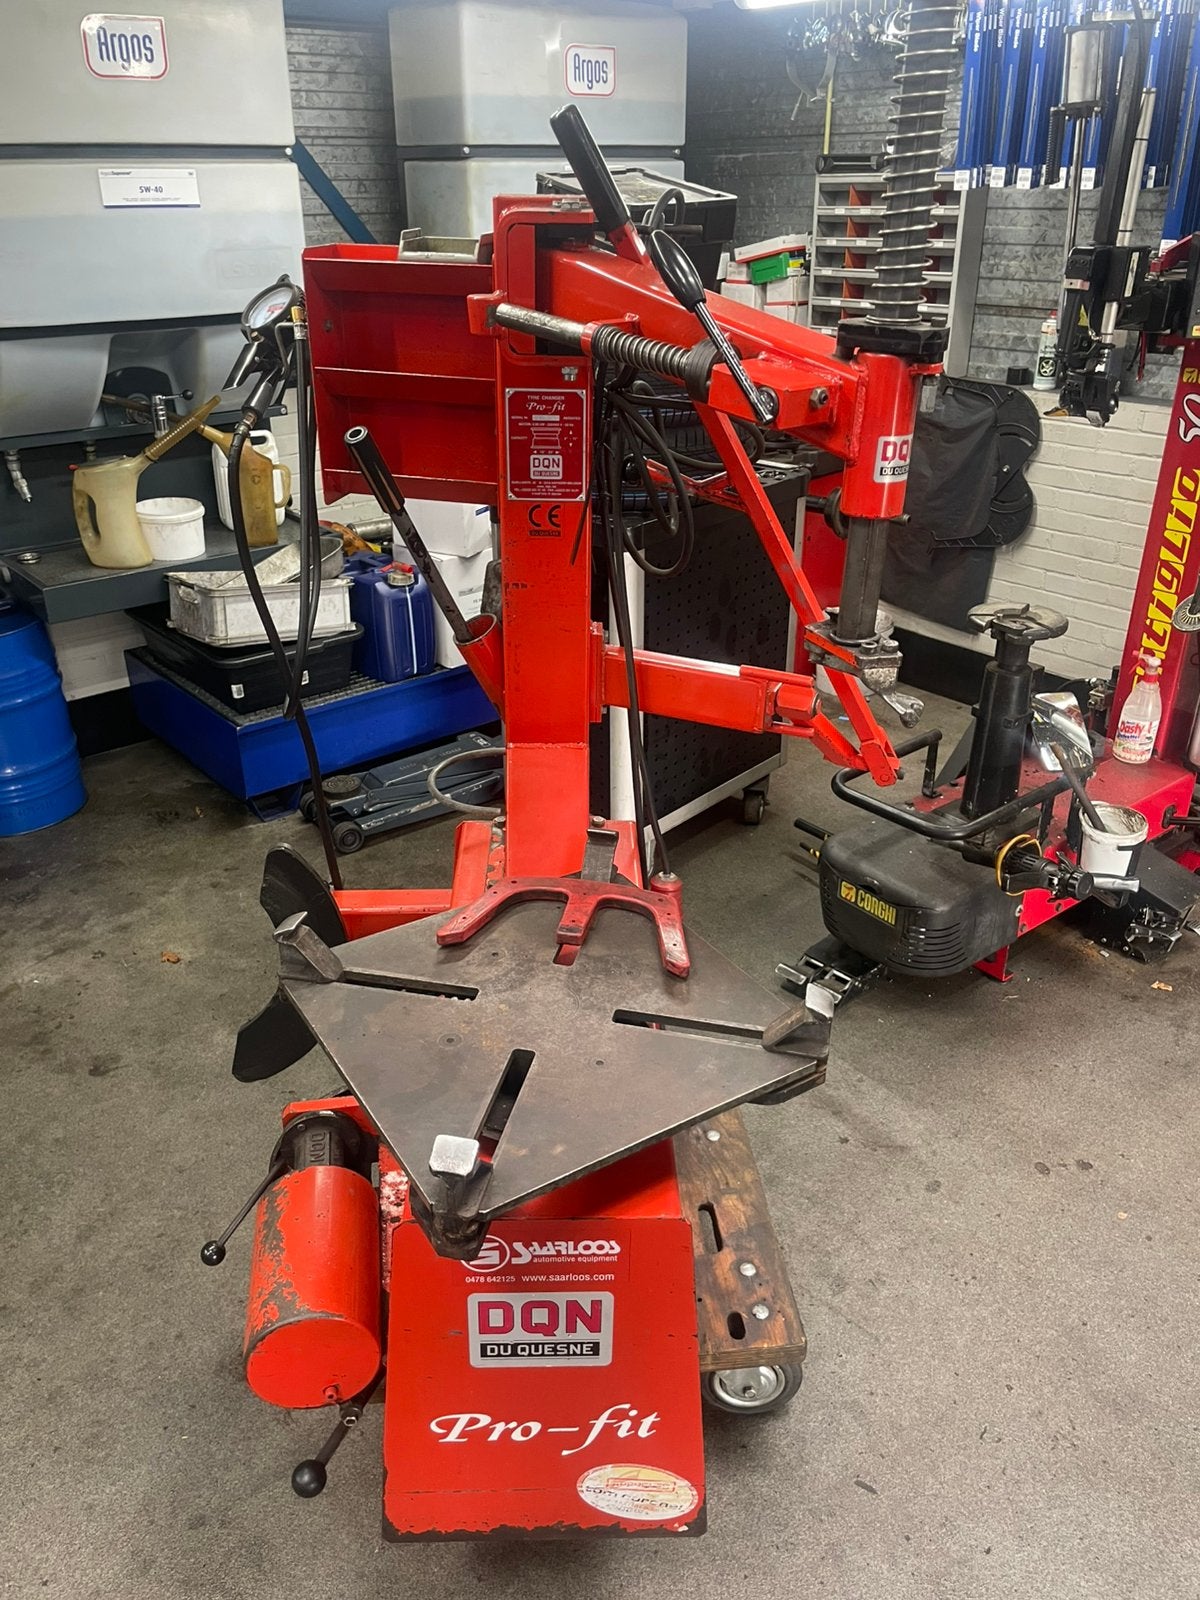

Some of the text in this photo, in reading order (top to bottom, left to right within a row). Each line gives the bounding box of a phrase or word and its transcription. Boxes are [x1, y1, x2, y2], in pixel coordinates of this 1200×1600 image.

[96, 26, 154, 72] Argos
[573, 52, 609, 91] Argos
[532, 457, 560, 469] DQN
[882, 467, 895, 475] DU
[528, 503, 561, 528] CE
[1119, 719, 1145, 738] Dasty
[857, 889, 897, 926] CORGHI
[310, 1130, 326, 1163] DQN
[532, 1255, 618, 1263] automotive equipment
[465, 1272, 615, 1283] 0478 642125 www.saarloos.com
[477, 1299, 603, 1337] DQN
[486, 1343, 594, 1356] DU QUESNE
